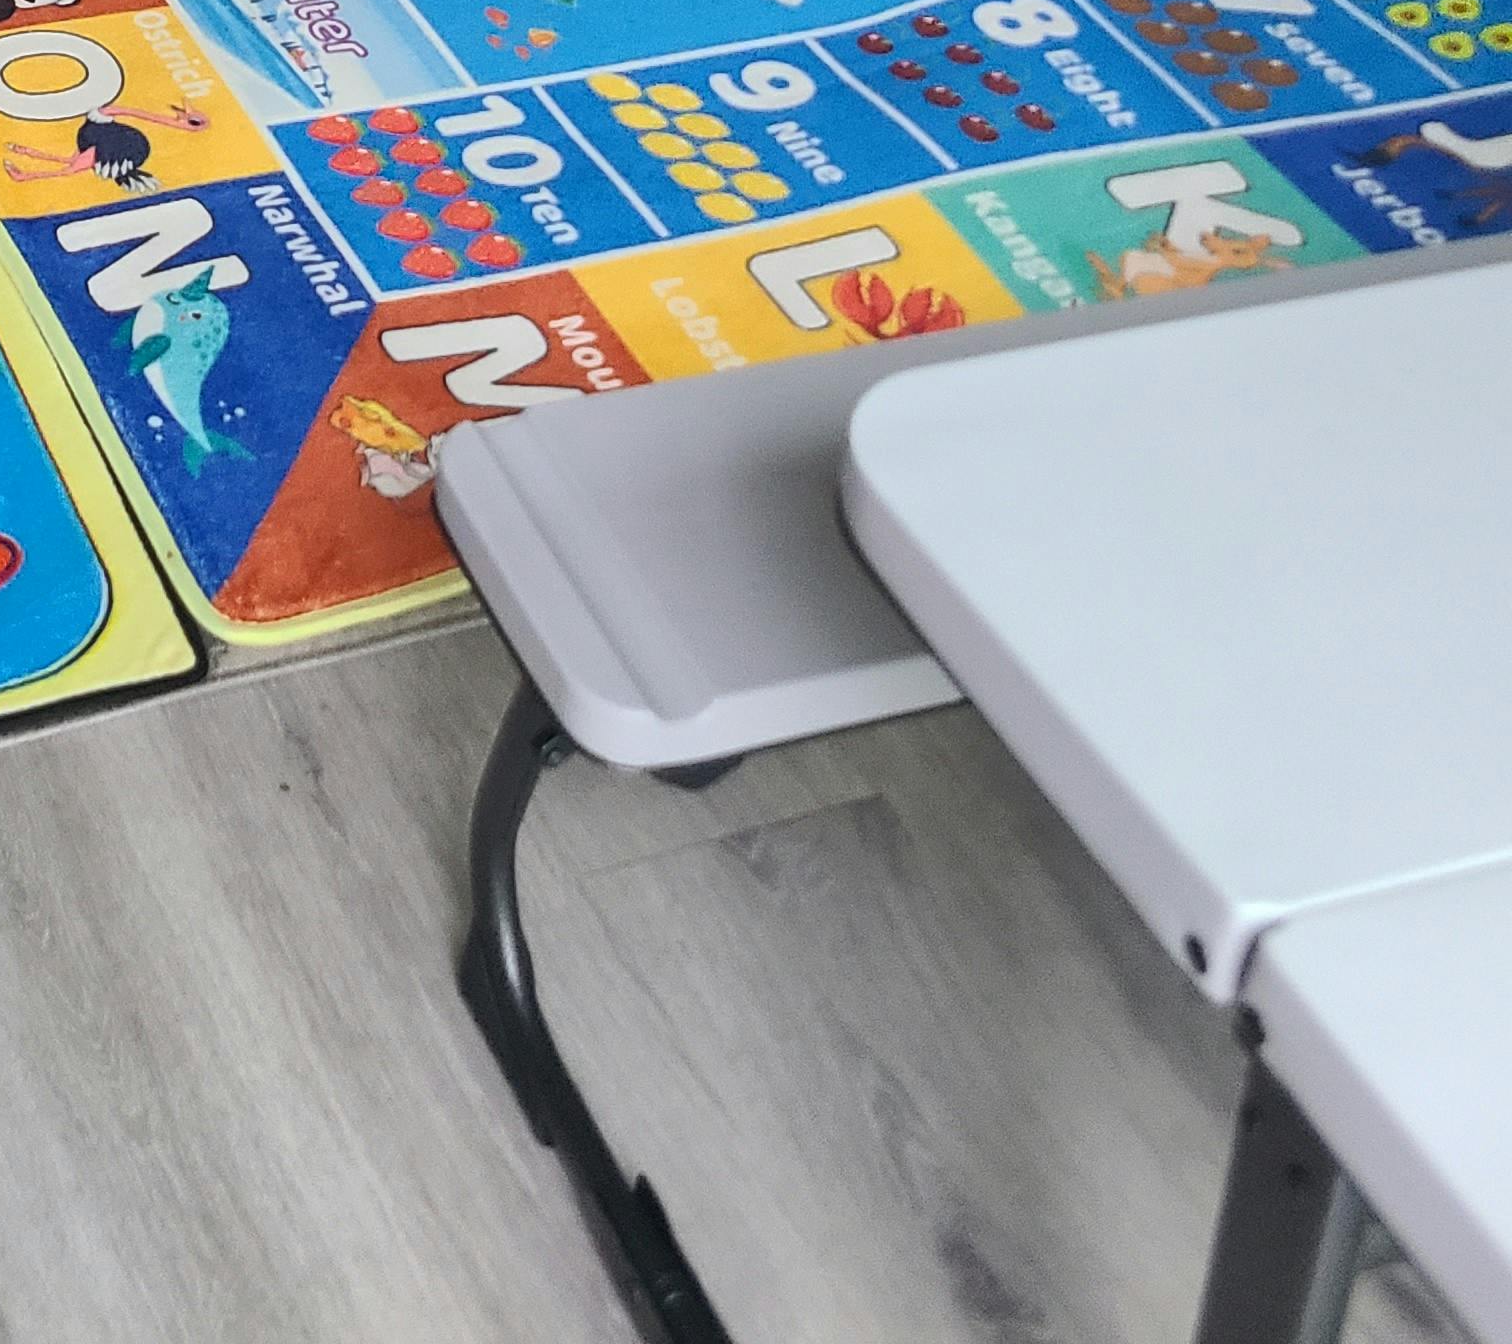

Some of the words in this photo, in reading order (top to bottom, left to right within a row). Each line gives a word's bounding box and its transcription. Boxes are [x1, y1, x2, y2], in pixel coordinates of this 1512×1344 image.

[131, 9, 216, 102] Ostrich
[709, 59, 817, 112] 9
[1043, 47, 1139, 130] Eight
[1263, 21, 1376, 104] Seven
[434, 95, 564, 188] 10
[766, 120, 848, 187] Nine
[54, 197, 252, 313] N
[246, 181, 371, 321] Narwhal
[520, 185, 580, 246] Ten
[1105, 159, 1306, 259] K
[745, 225, 902, 332] L
